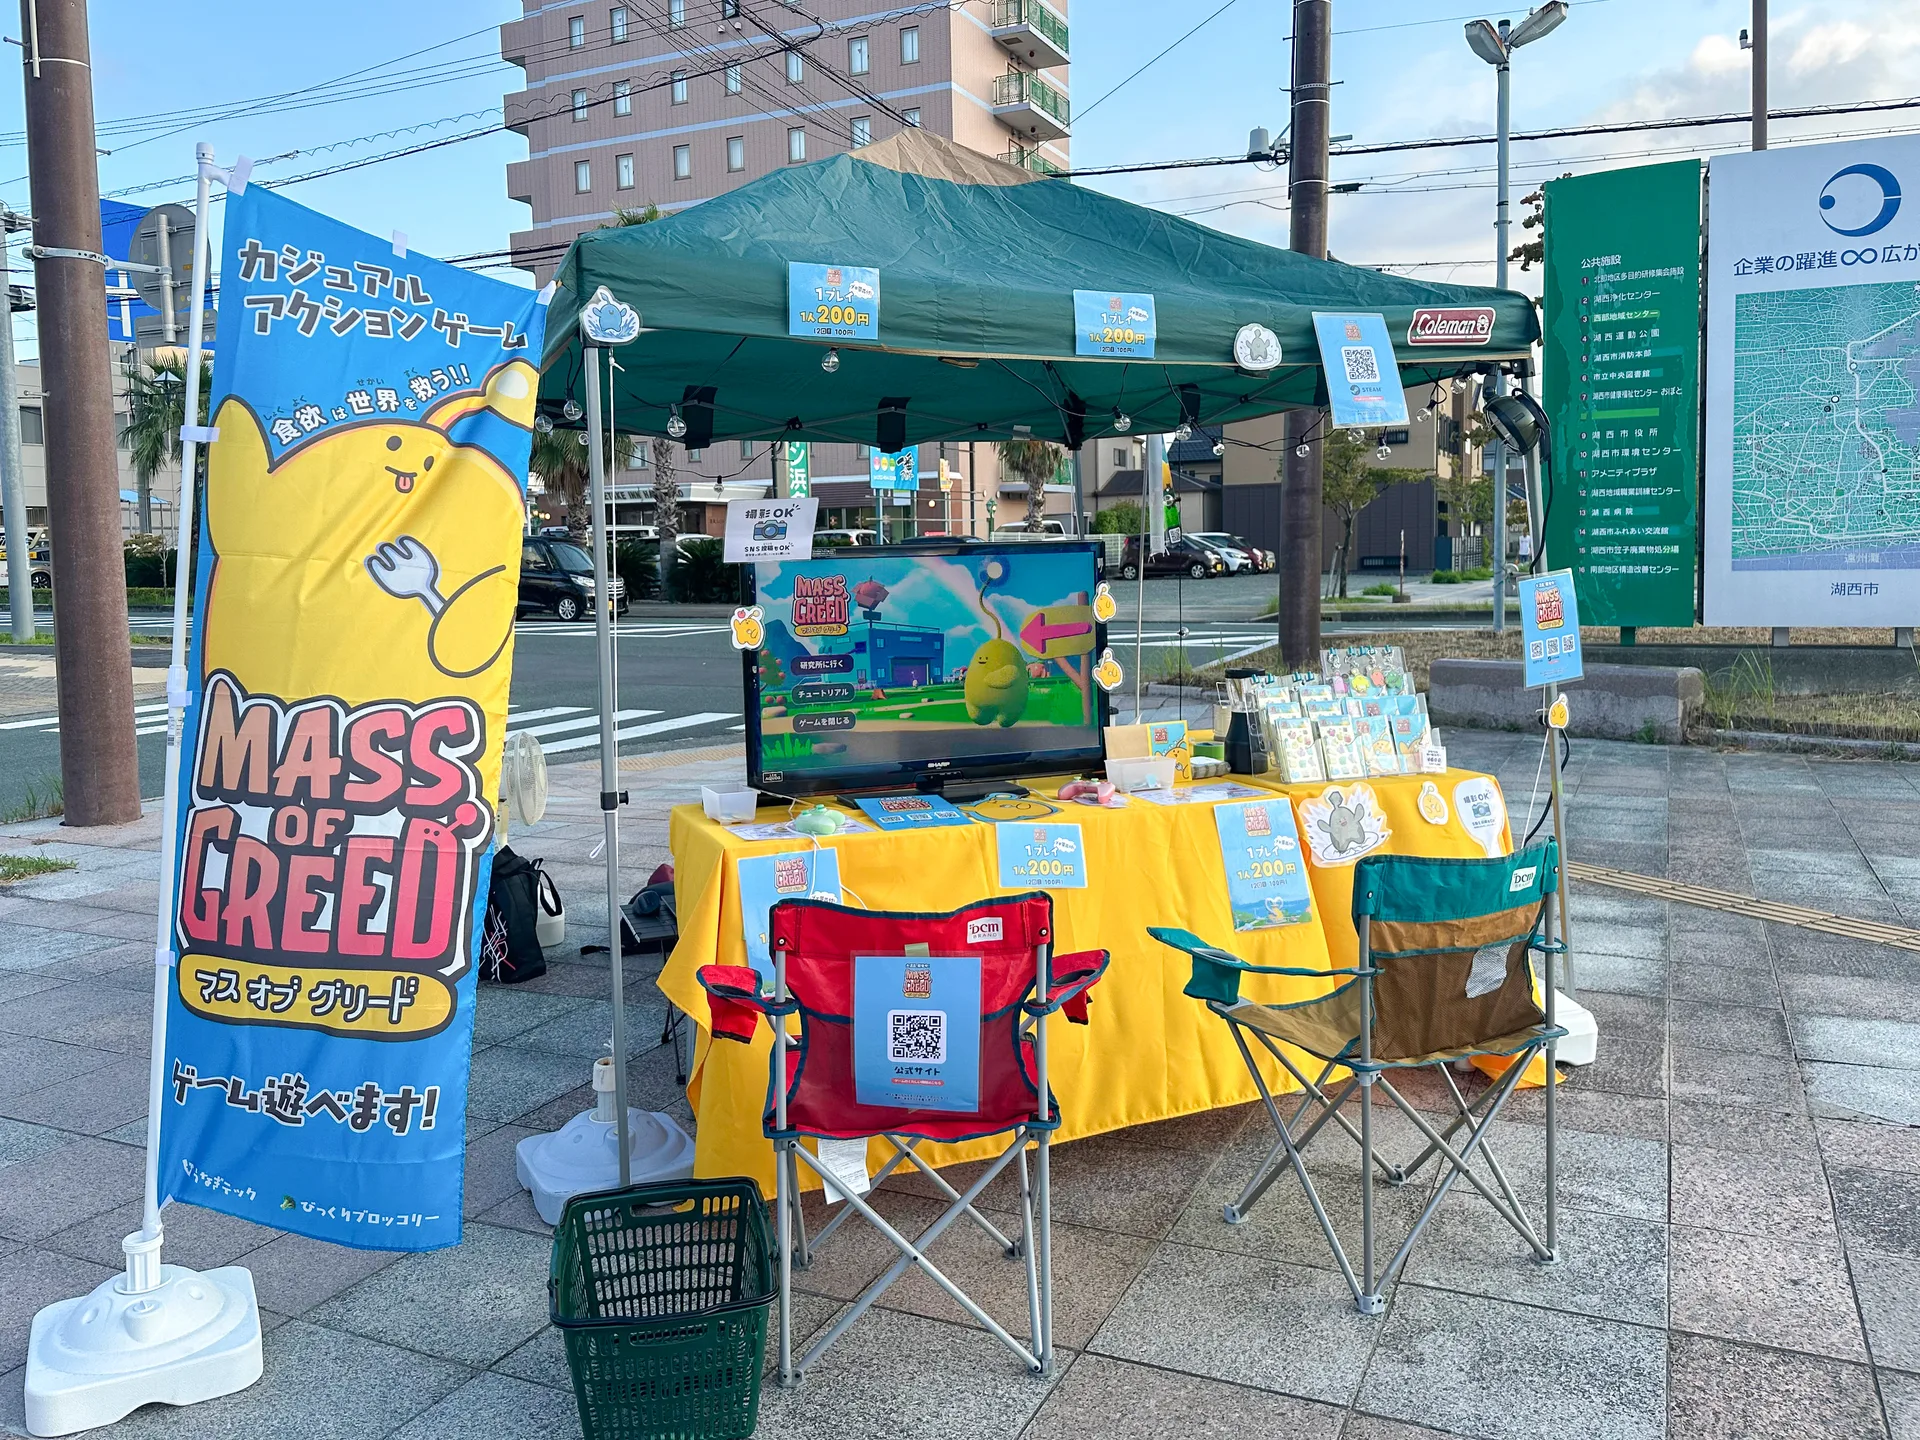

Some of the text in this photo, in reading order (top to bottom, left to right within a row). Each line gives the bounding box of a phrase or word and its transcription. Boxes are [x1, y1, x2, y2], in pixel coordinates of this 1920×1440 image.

[1581, 254, 1621, 269] 公共施設
[238, 238, 433, 305] カジュアル
[815, 287, 854, 303] 1プレイ
[1594, 290, 1660, 303] 湖西浄化センター
[243, 289, 529, 350] アクションゲーム
[1593, 310, 1659, 322] 西部地域センター
[1416, 313, 1476, 335] Coleman
[1593, 328, 1660, 342] 湖西運動公園
[1594, 349, 1652, 362] 湖西市消防本部
[1593, 369, 1650, 381] 市立中央図書館
[1592, 428, 1658, 440] 湖西市役所
[1592, 447, 1681, 458] 湖西市環境センター
[1592, 467, 1657, 477] アメニティプラザ
[1591, 507, 1633, 517] 湖西病院
[1592, 526, 1669, 536] 湖西市ふれあい交流館
[796, 575, 845, 597] MASS
[1831, 582, 1879, 596] 湖西市
[795, 598, 846, 623] GREED
[800, 660, 843, 669] 研究所に行く
[798, 689, 849, 698] チュートリアル
[799, 717, 850, 727] ゲームを閉じる
[200, 680, 467, 806] MASS
[274, 806, 346, 847] OF
[776, 857, 803, 871] MASS
[182, 804, 477, 959] GREED
[196, 970, 419, 1024] マス オブ グリード
[894, 1066, 940, 1076] 公式サイト
[172, 1057, 440, 1136] ゲーム遊べます!
[301, 1200, 440, 1227] びっくりブロッコリー
